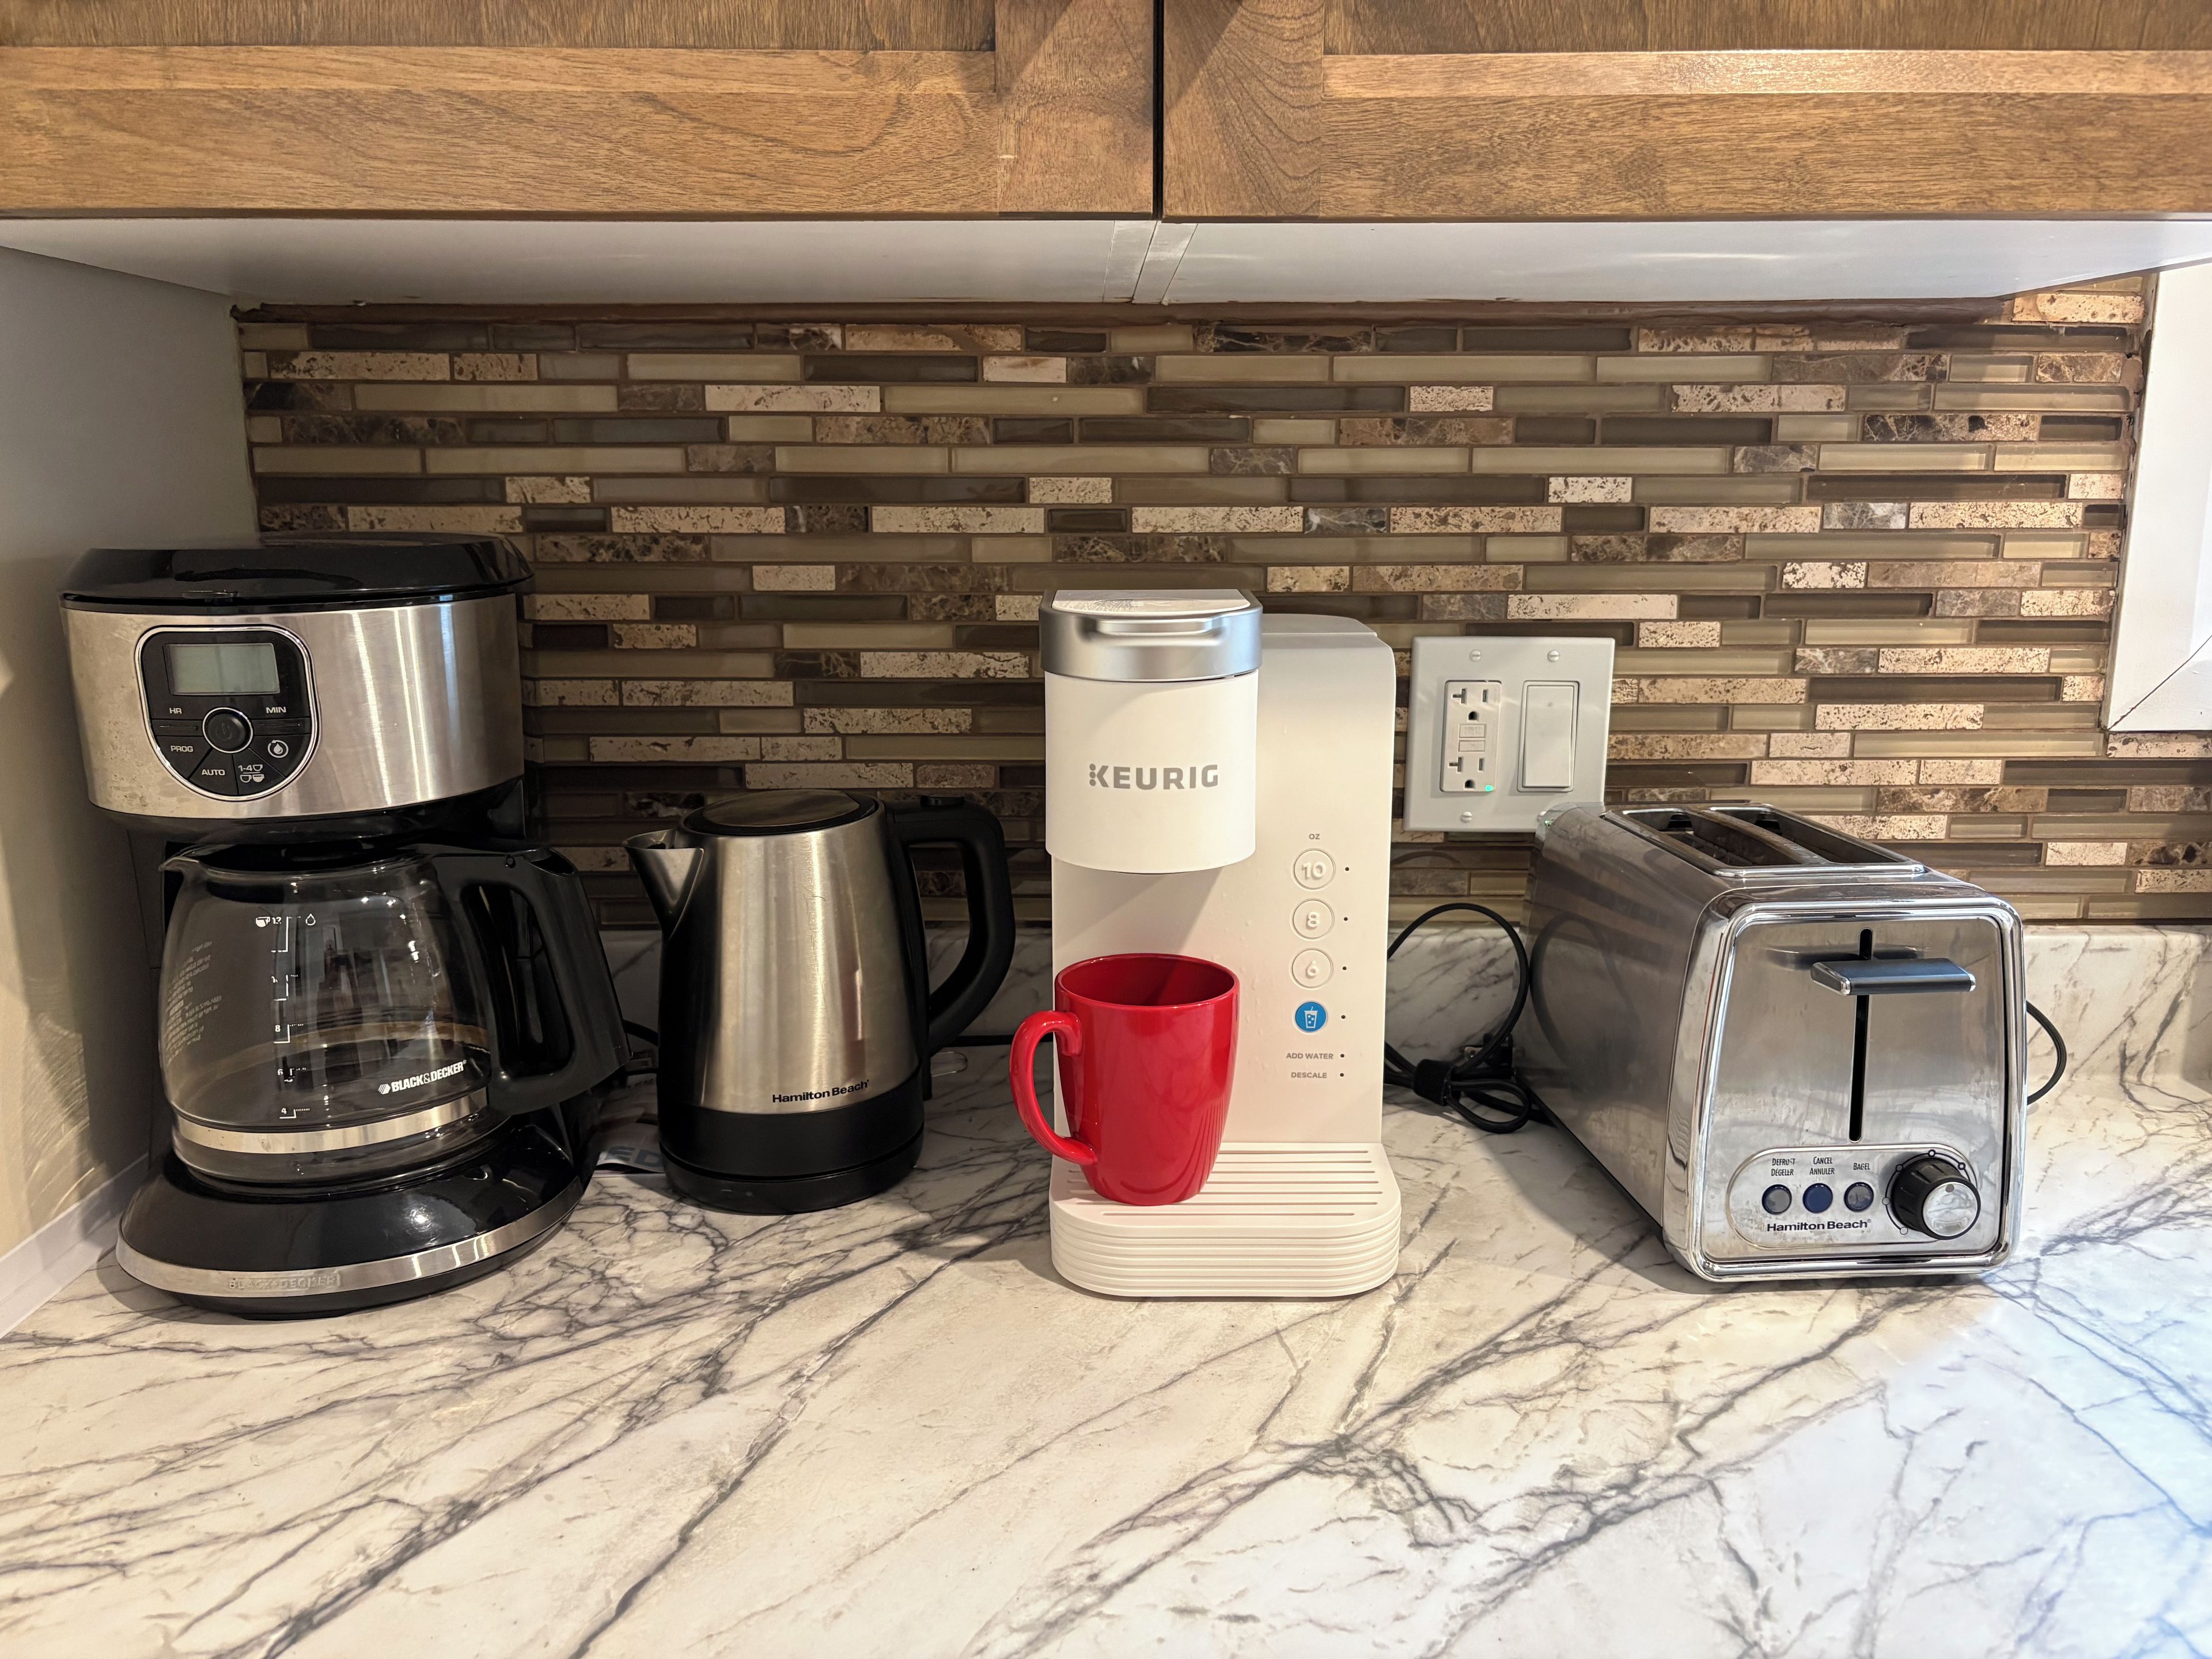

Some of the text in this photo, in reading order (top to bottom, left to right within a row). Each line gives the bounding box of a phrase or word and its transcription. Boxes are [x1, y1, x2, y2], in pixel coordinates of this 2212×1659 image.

[1089, 763, 1218, 790] KEURIG
[1301, 862, 1327, 881] 10
[1306, 911, 1320, 930] 8
[1305, 960, 1319, 979] 6
[772, 1081, 868, 1103] Hamilton Beach
[1853, 1162, 1871, 1171] BAGEL
[1767, 1219, 1868, 1232] Hamilton Beach
